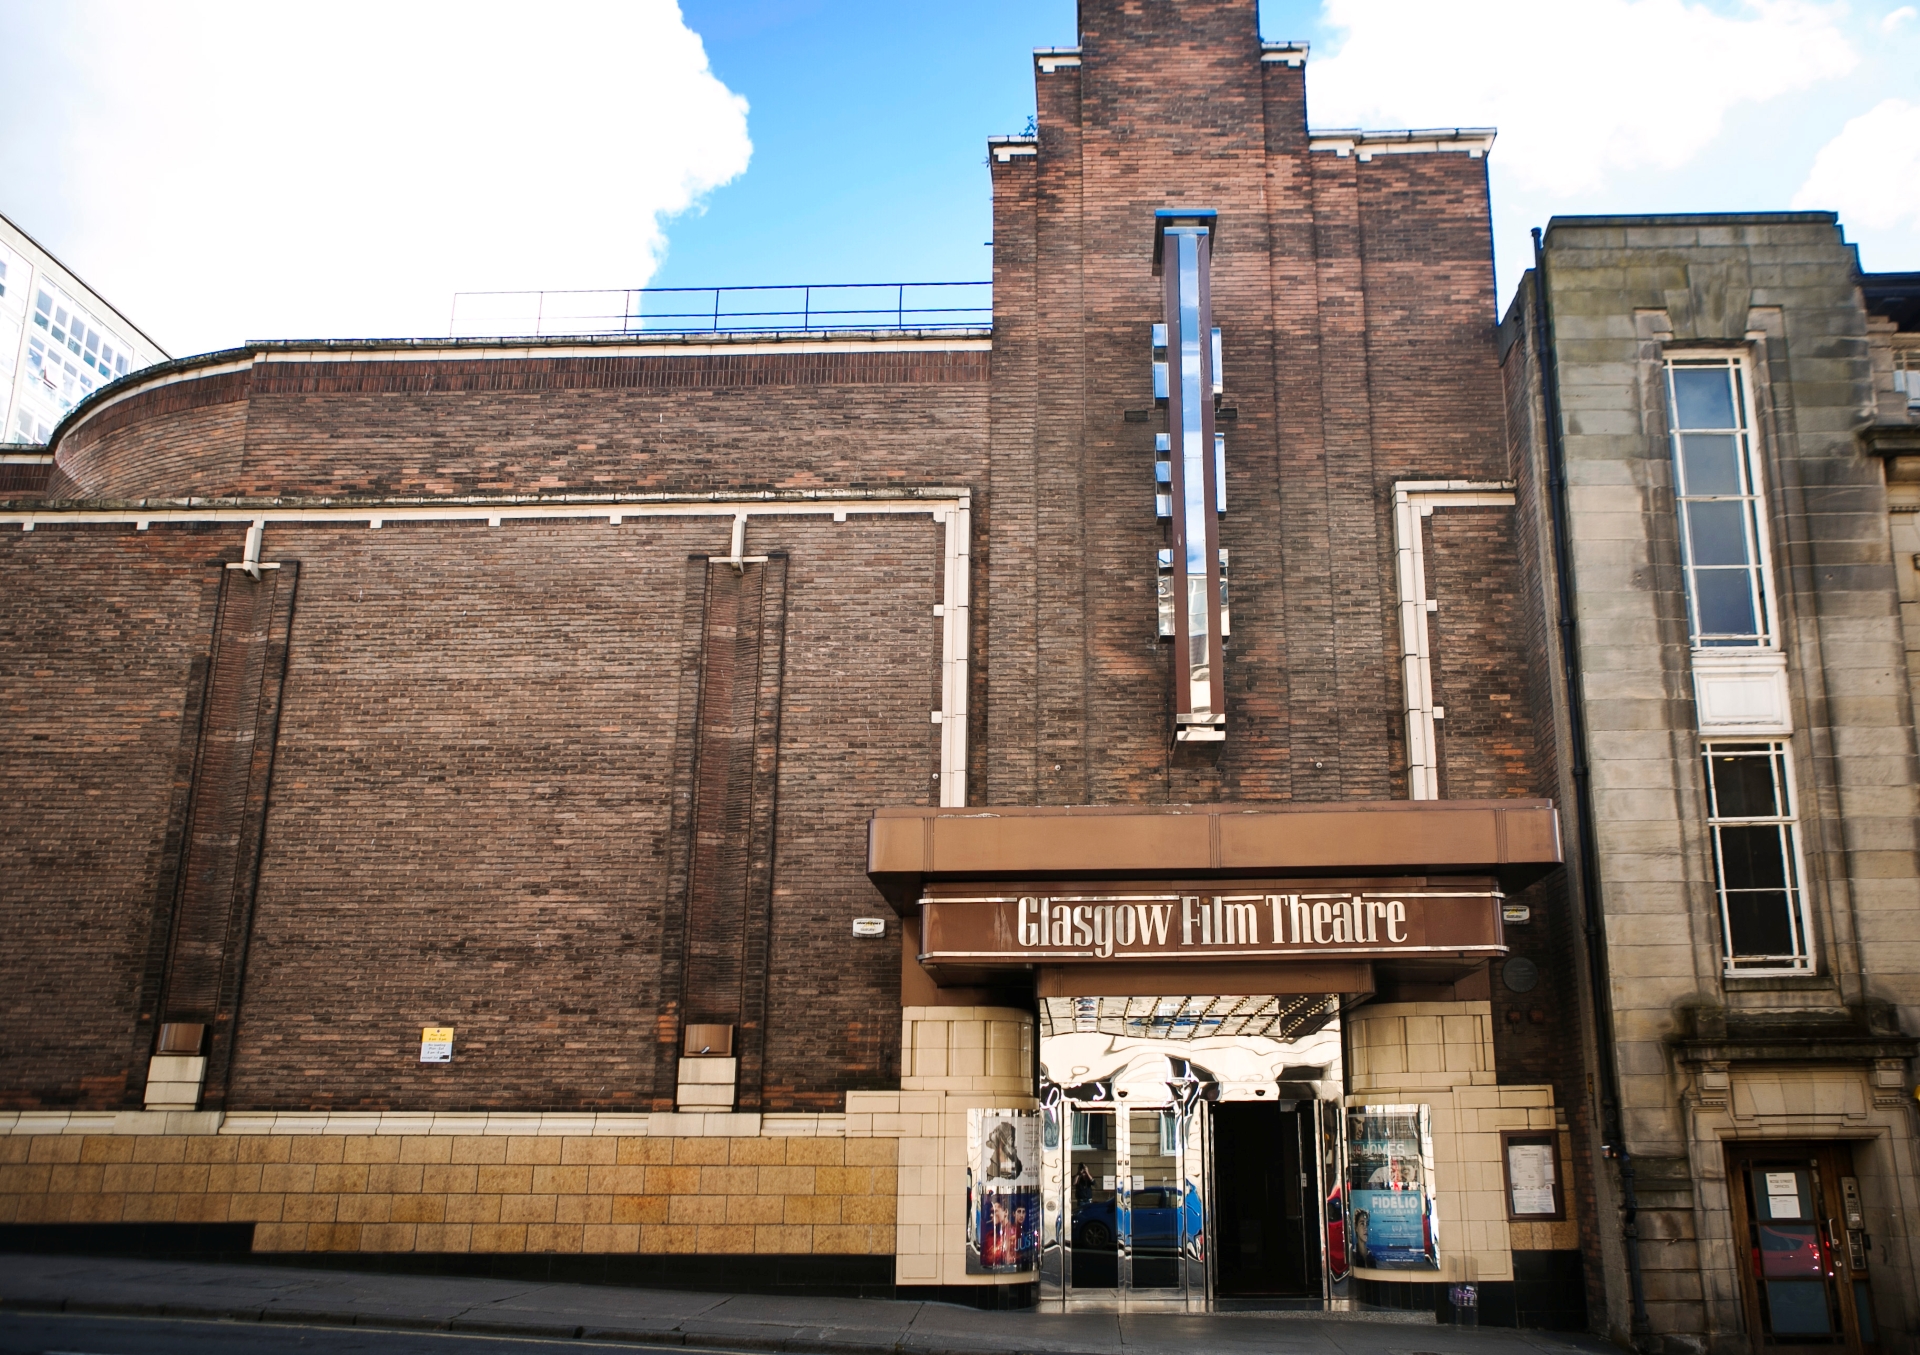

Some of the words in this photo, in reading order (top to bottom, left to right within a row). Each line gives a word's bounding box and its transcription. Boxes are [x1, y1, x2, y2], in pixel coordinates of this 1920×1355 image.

[1016, 896, 1173, 958] Glasgow
[1181, 896, 1259, 945] Film
[1266, 894, 1408, 945] Theatre
[1362, 1143, 1405, 1156] HOMES
[1372, 1196, 1418, 1209] FIDELIO
